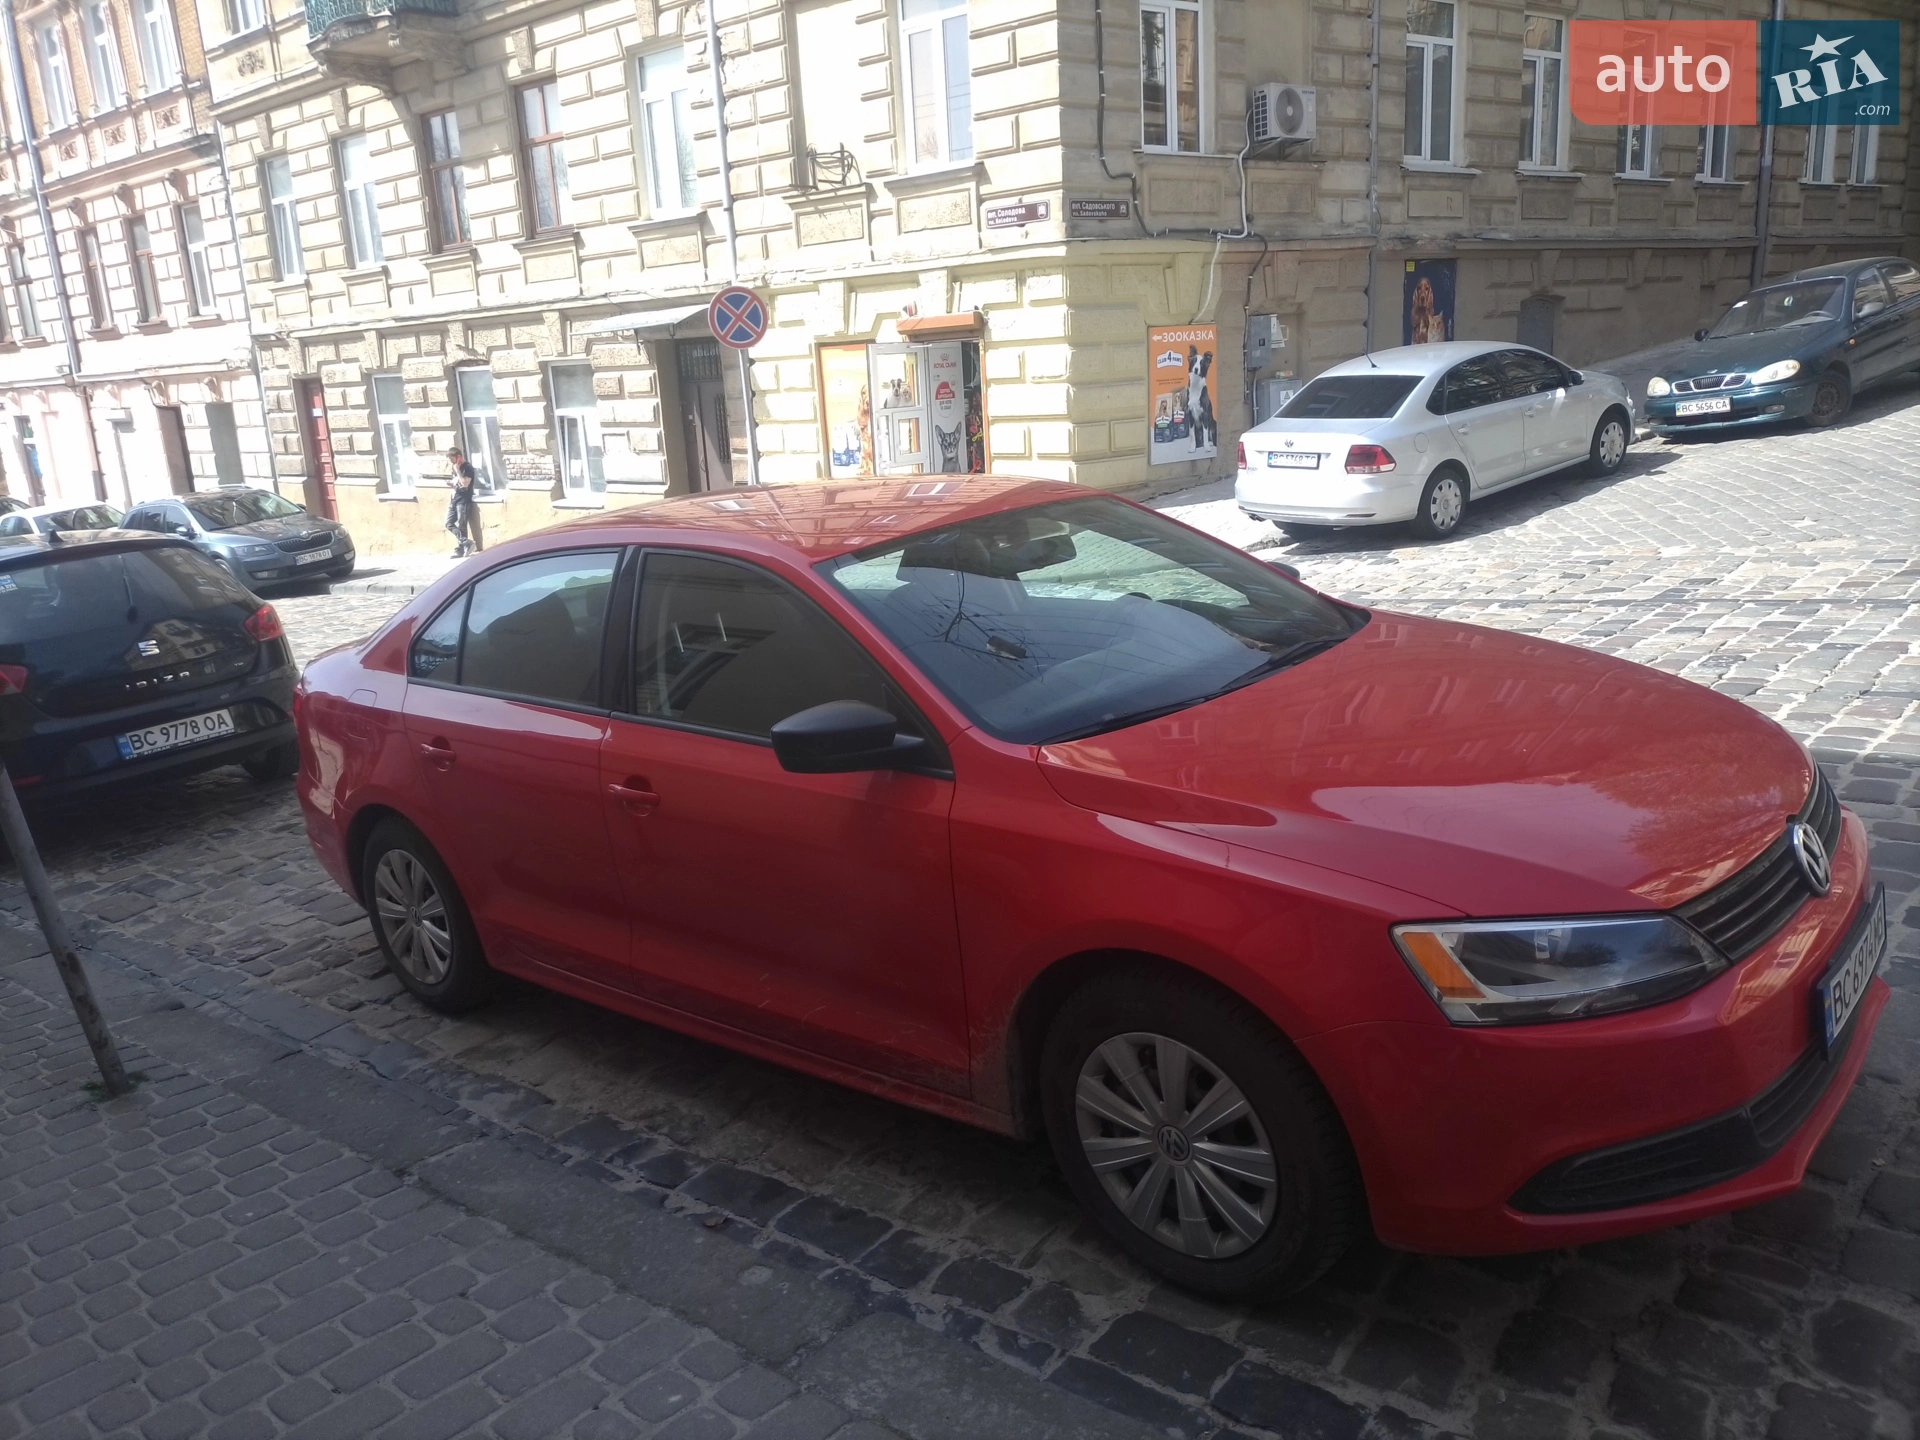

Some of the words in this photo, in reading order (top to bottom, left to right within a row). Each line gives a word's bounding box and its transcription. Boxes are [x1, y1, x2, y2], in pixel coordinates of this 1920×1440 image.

[997, 207, 1026, 217] Солодова
[1081, 202, 1115, 210] Садовського
[1162, 330, 1214, 342] ЗООКАЗКА
[1167, 351, 1172, 362] 4
[1681, 404, 1693, 413] BC
[1695, 402, 1714, 411] 5656
[1715, 400, 1728, 409] CA
[128, 731, 158, 751] BC
[160, 720, 201, 743] 9778
[203, 713, 230, 732] OA
[1832, 968, 1852, 1027] BC
[1853, 921, 1874, 994] 6974
